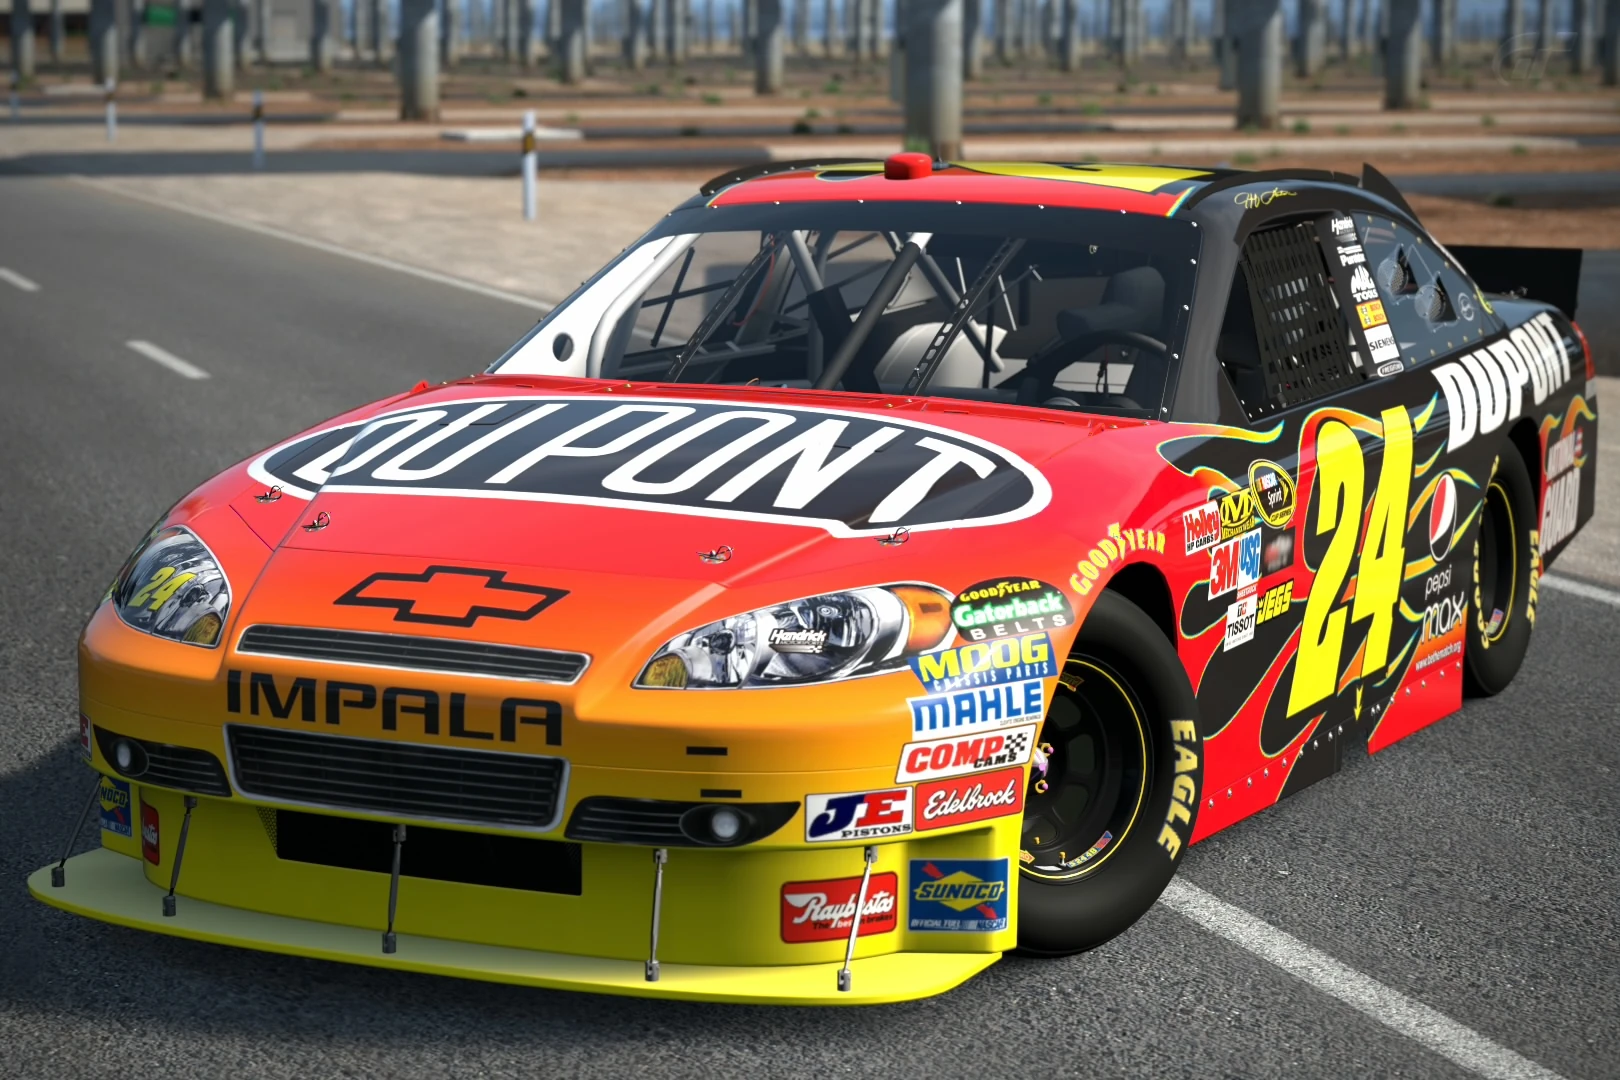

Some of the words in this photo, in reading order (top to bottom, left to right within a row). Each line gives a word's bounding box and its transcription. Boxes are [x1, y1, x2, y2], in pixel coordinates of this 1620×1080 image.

[1430, 311, 1571, 454] DUPONT
[1267, 487, 1283, 509] Sprint
[1539, 466, 1580, 558] GUARD
[1184, 508, 1220, 544] Holley
[1186, 540, 1195, 553] HP
[1195, 534, 1214, 549] CARBS
[1069, 522, 1166, 597] GOODYEAR
[1210, 541, 1240, 595] 3M
[1240, 532, 1261, 580] USG
[1286, 404, 1414, 719] 24
[127, 566, 198, 611] 24
[959, 579, 1041, 602] GOODYEAR
[1255, 580, 1294, 625] JEGS
[1424, 564, 1452, 601] pepsi
[953, 592, 1063, 628] Gatorback
[970, 614, 1067, 640] BELTS
[1227, 613, 1255, 639] TISSOT
[1421, 591, 1465, 645] max
[770, 629, 827, 645] Hendrick
[917, 633, 1049, 683] MOOG
[933, 669, 997, 692] CHASSIS
[1005, 662, 1049, 680] PARTS
[226, 669, 563, 746] IMPALA
[910, 680, 1042, 732] MAHLE
[905, 735, 1005, 774] COMP
[973, 752, 1017, 769] CAMS
[100, 786, 127, 806] NOCO
[922, 779, 1016, 820] Edelbrock
[1156, 719, 1198, 861] EAGLE
[809, 789, 908, 838] JE
[841, 823, 912, 839] PISTONS
[784, 890, 895, 930] Raybstos
[918, 883, 1002, 900] SUNOCO
